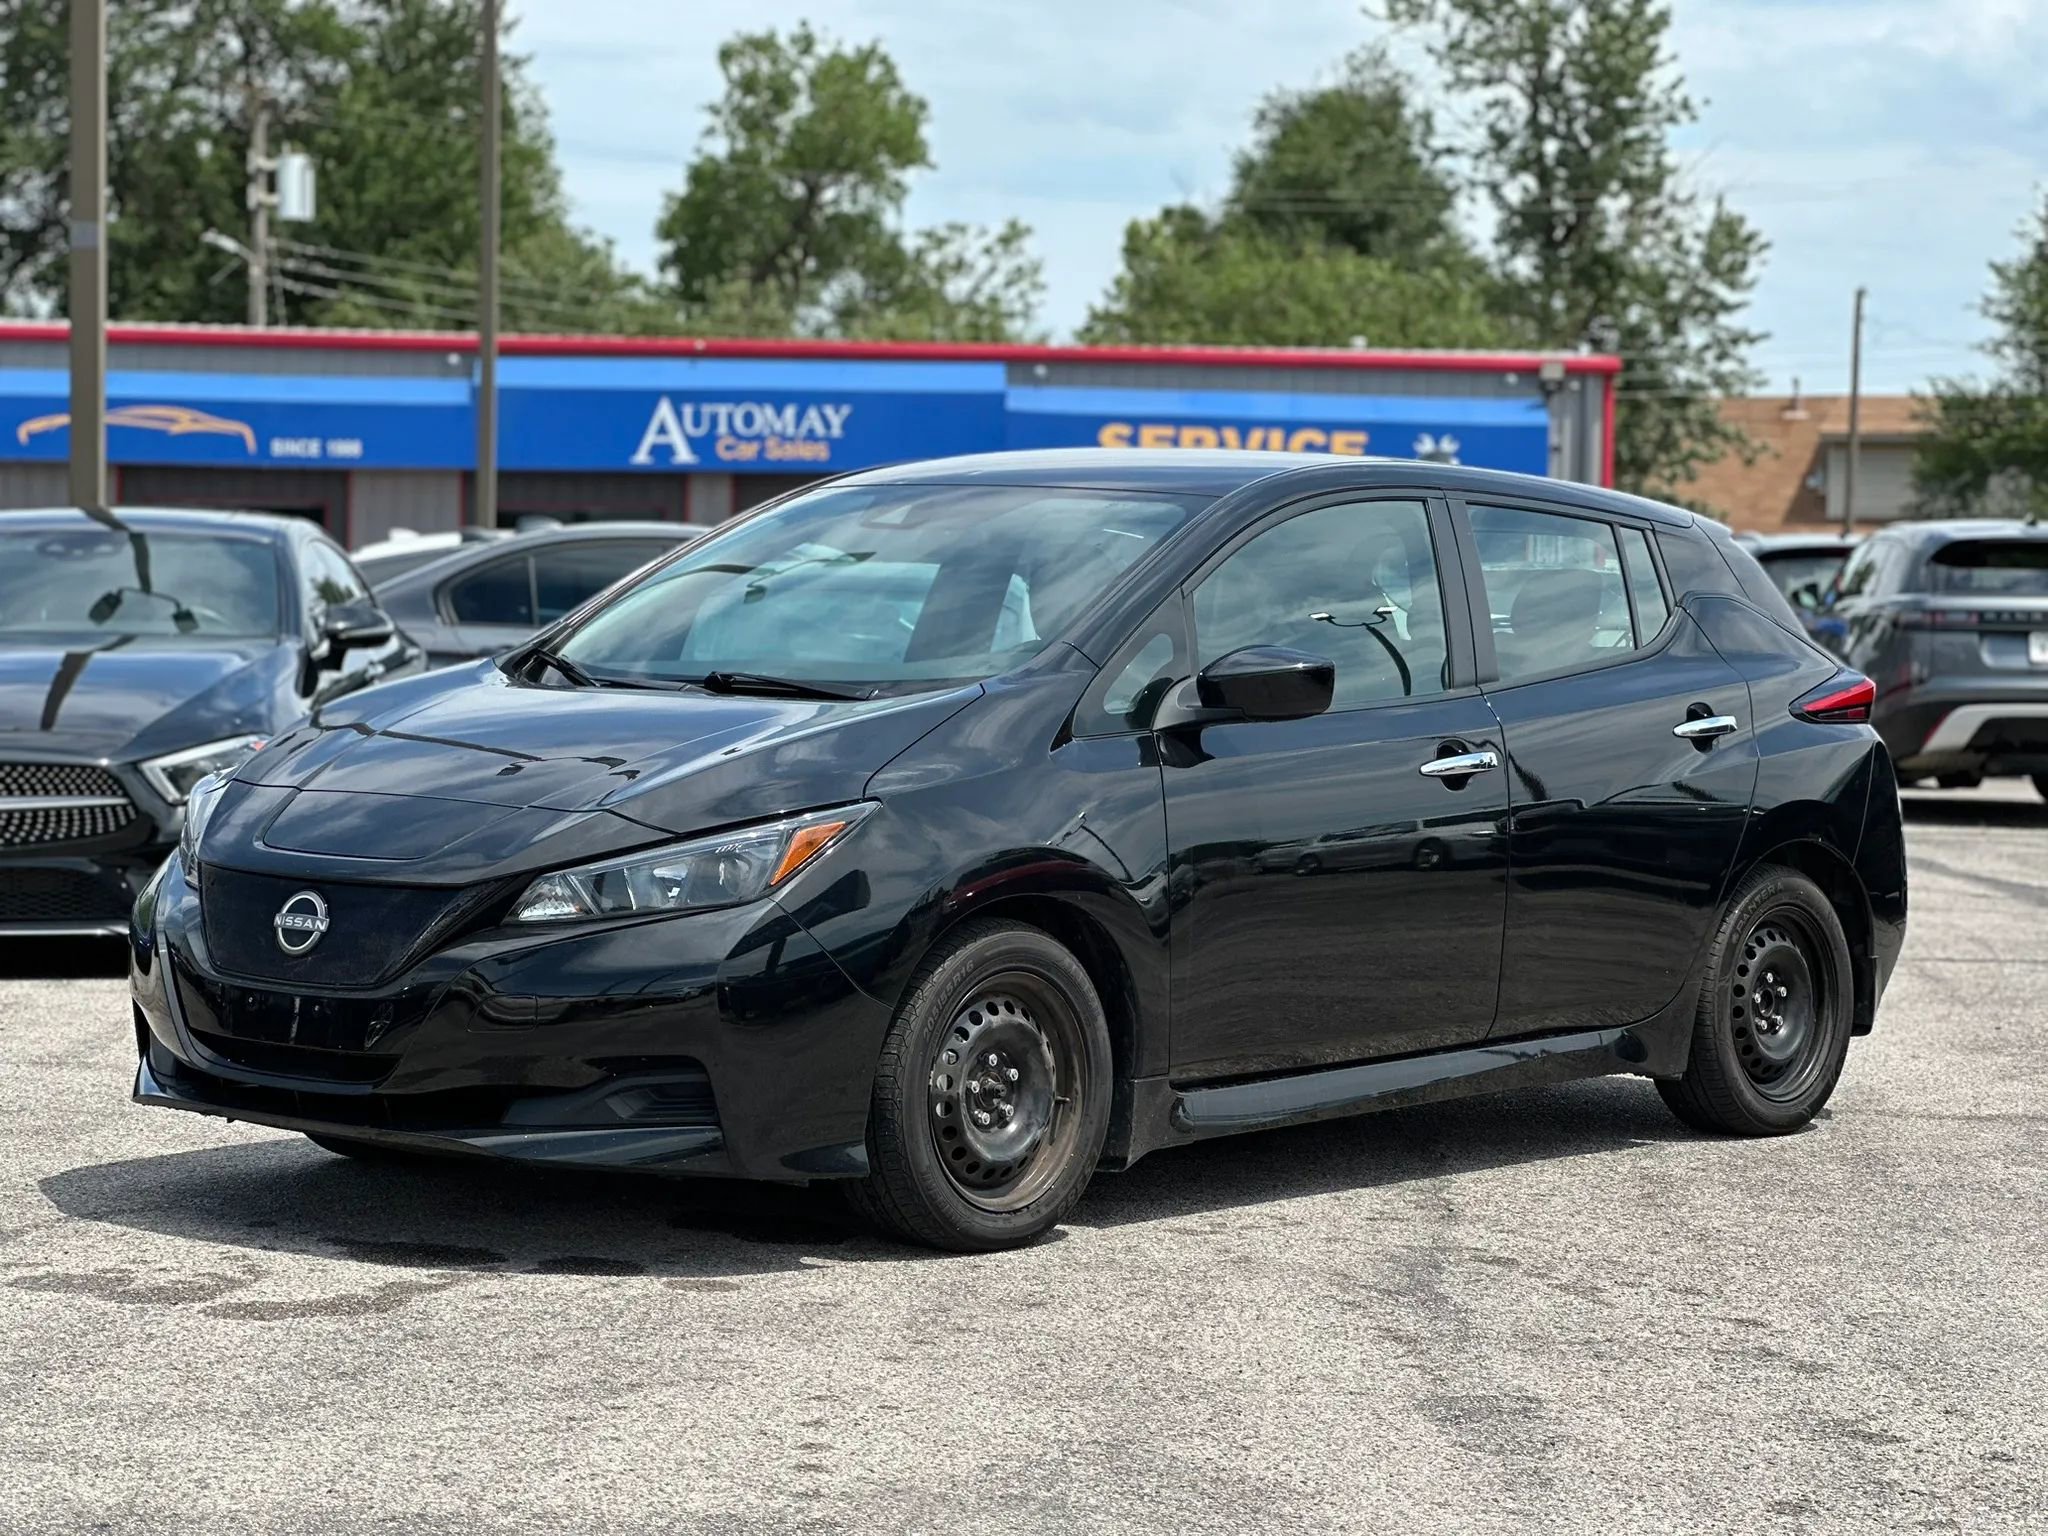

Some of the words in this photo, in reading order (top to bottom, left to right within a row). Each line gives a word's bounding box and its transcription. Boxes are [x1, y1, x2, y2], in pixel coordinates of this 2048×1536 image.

[629, 394, 853, 465] AUTOMAY
[270, 437, 321, 458] SINCE
[715, 435, 761, 461] Car
[764, 436, 832, 462] Sales
[1736, 882, 1784, 934] PANTERA
[274, 915, 327, 931] NISSAN
